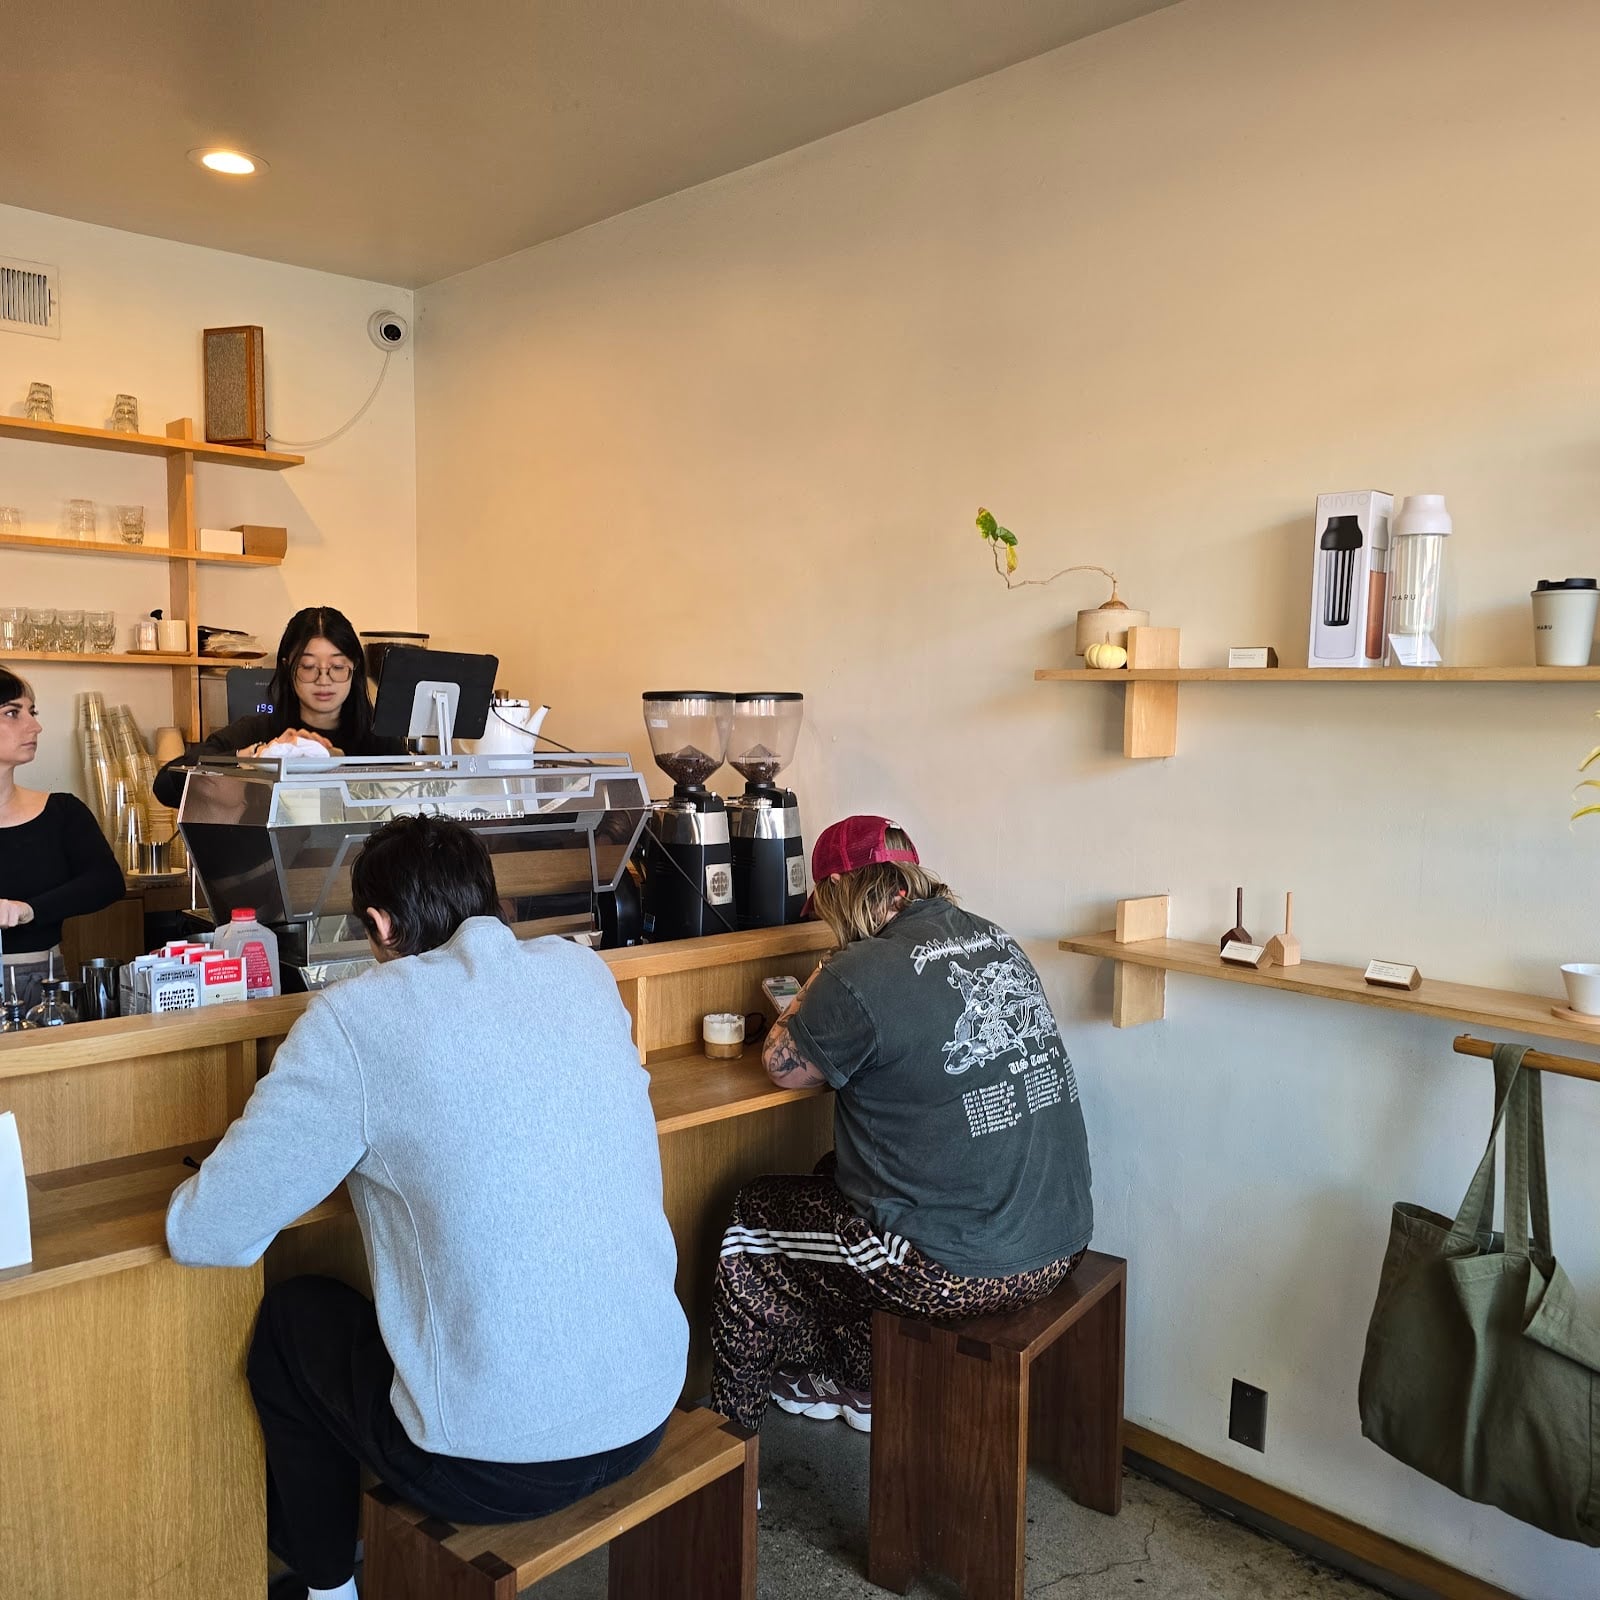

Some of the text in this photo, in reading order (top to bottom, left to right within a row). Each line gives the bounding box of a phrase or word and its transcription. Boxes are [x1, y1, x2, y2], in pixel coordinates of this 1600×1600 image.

[1320, 493, 1369, 509] KINTO
[1392, 593, 1416, 601] MARU
[256, 703, 274, 714] 199
[159, 994, 186, 1002] PRACTICE
[159, 999, 183, 1008] PREPARE
[1008, 1058, 1029, 1075] US
[1029, 1052, 1049, 1067] Tour
